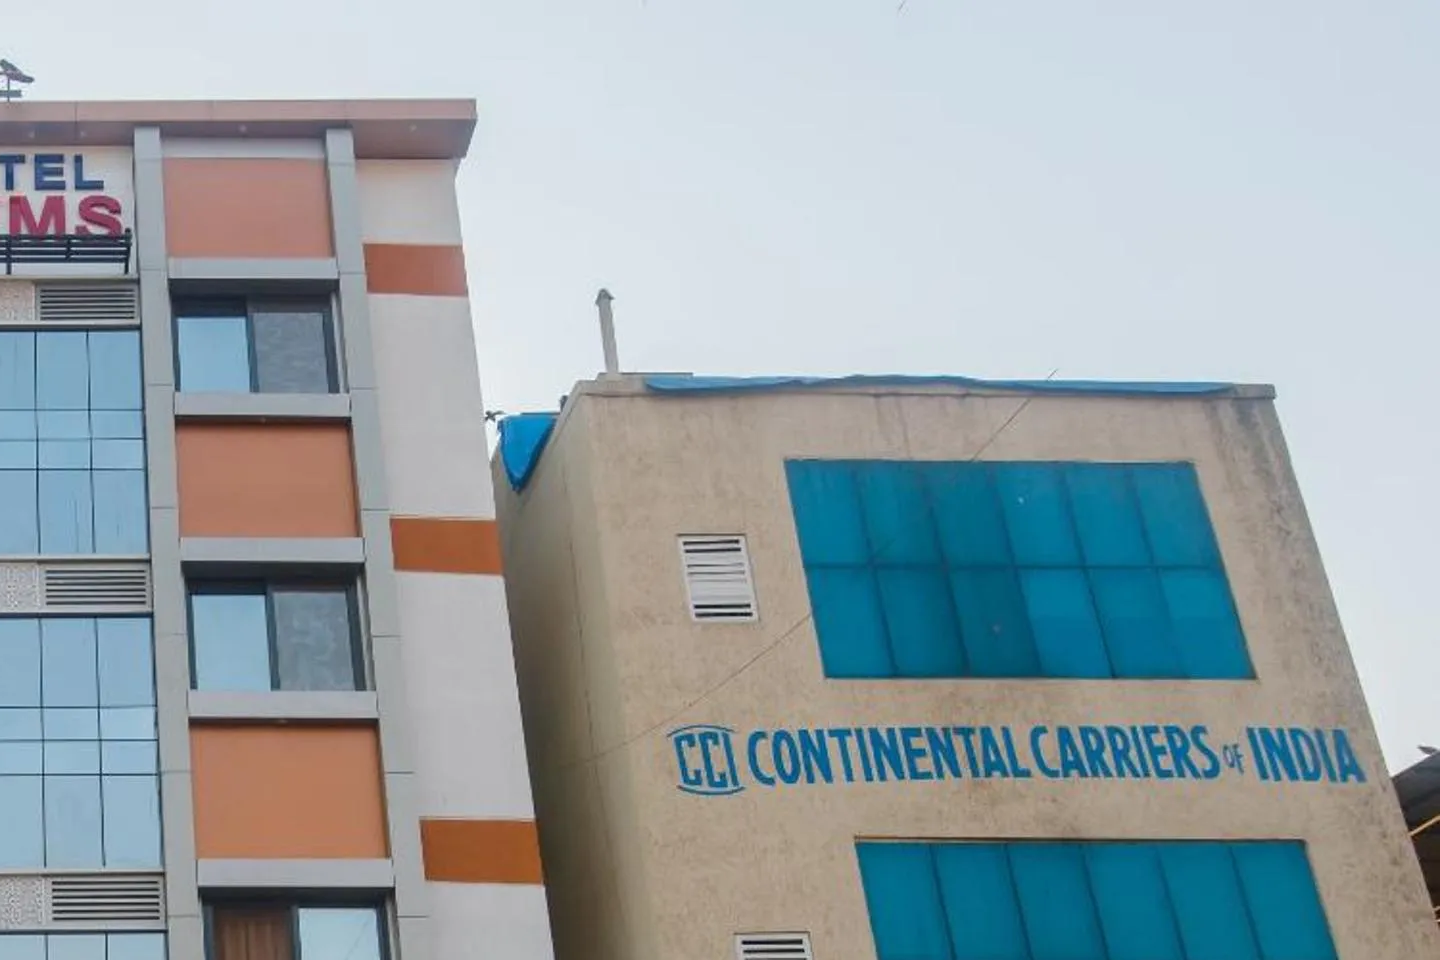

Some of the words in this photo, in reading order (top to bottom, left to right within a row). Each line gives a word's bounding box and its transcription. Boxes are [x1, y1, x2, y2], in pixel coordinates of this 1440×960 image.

[673, 731, 739, 788] CCI
[747, 726, 1024, 785] CONTINENTAL
[1029, 725, 1220, 781] CARRIERS
[1222, 743, 1245, 774] OF
[1246, 726, 1366, 784] INDIA
